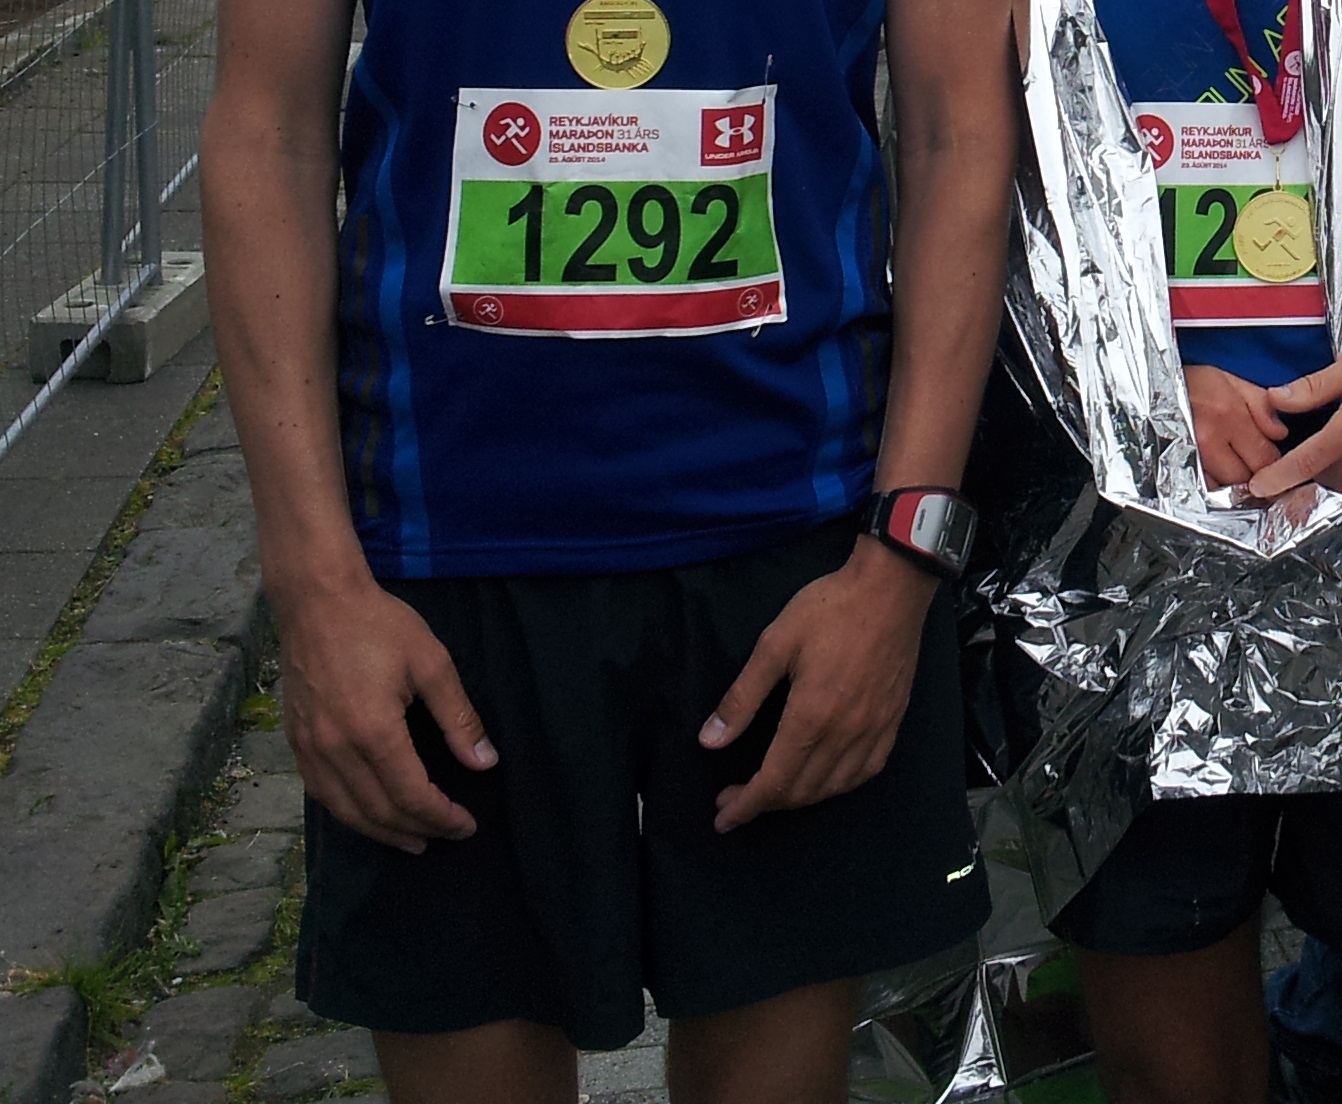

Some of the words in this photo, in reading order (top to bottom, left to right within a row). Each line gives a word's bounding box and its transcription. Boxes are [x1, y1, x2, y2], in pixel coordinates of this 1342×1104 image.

[549, 113, 639, 127] REYKJAVÍKUR
[549, 129, 614, 140] MARAÞON
[617, 129, 632, 140] 31
[634, 126, 660, 140] ÁRS
[1181, 125, 1252, 137] REYKJAVÍKUR
[548, 140, 649, 153] ÍSLANDSBANKA
[1181, 138, 1233, 148] MARAÞON
[1235, 138, 1246, 148] 31
[1181, 148, 1261, 160] ÍSLANDSBANKA
[507, 184, 740, 283] 1292
